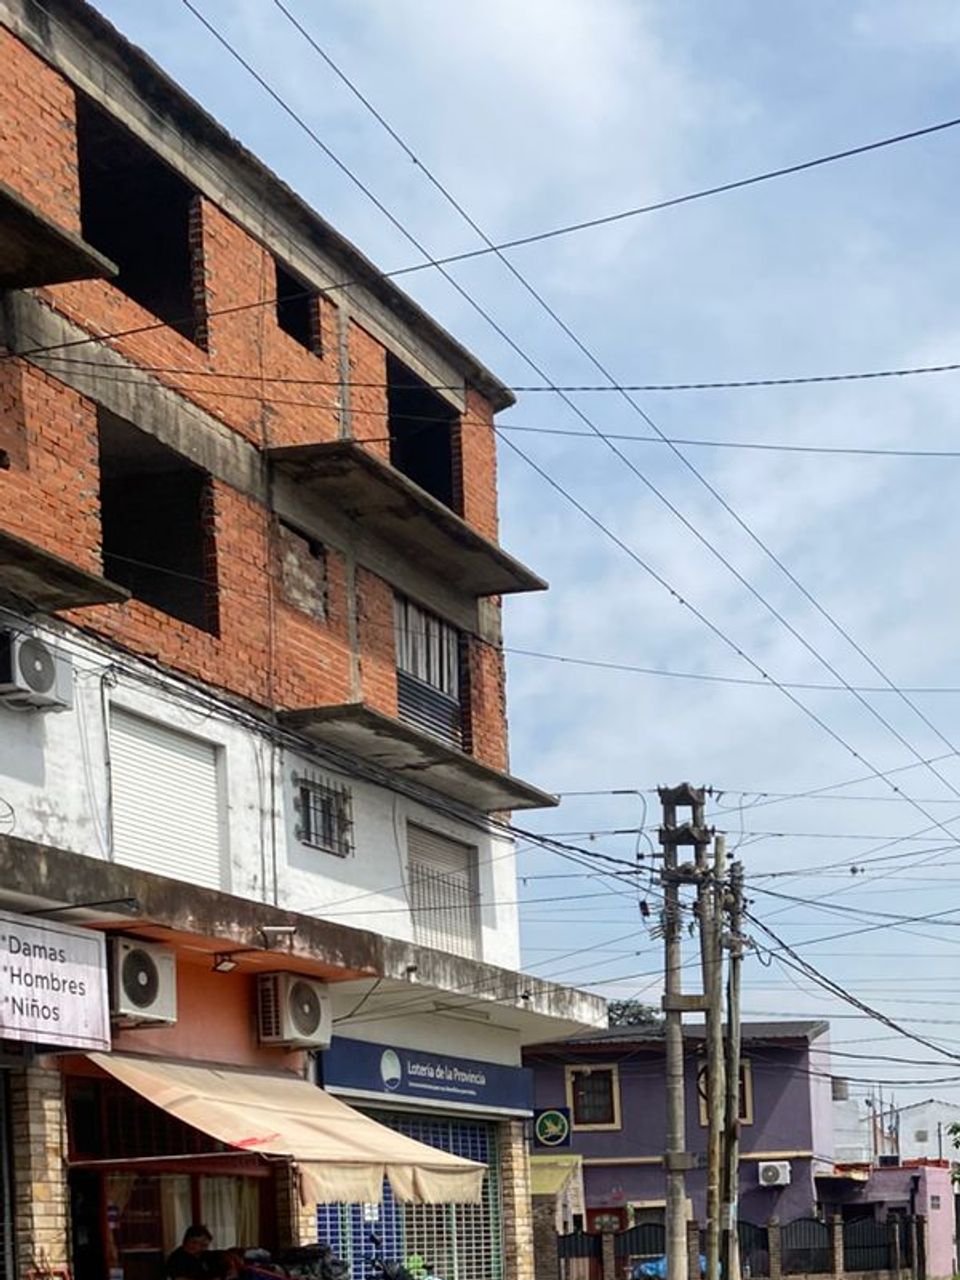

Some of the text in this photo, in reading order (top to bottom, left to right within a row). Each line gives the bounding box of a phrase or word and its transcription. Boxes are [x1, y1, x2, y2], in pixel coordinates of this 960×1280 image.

[9, 935, 66, 963] Damas
[10, 966, 86, 996] Hombres
[436, 1065, 445, 1079] de
[454, 1067, 486, 1085] Provincia
